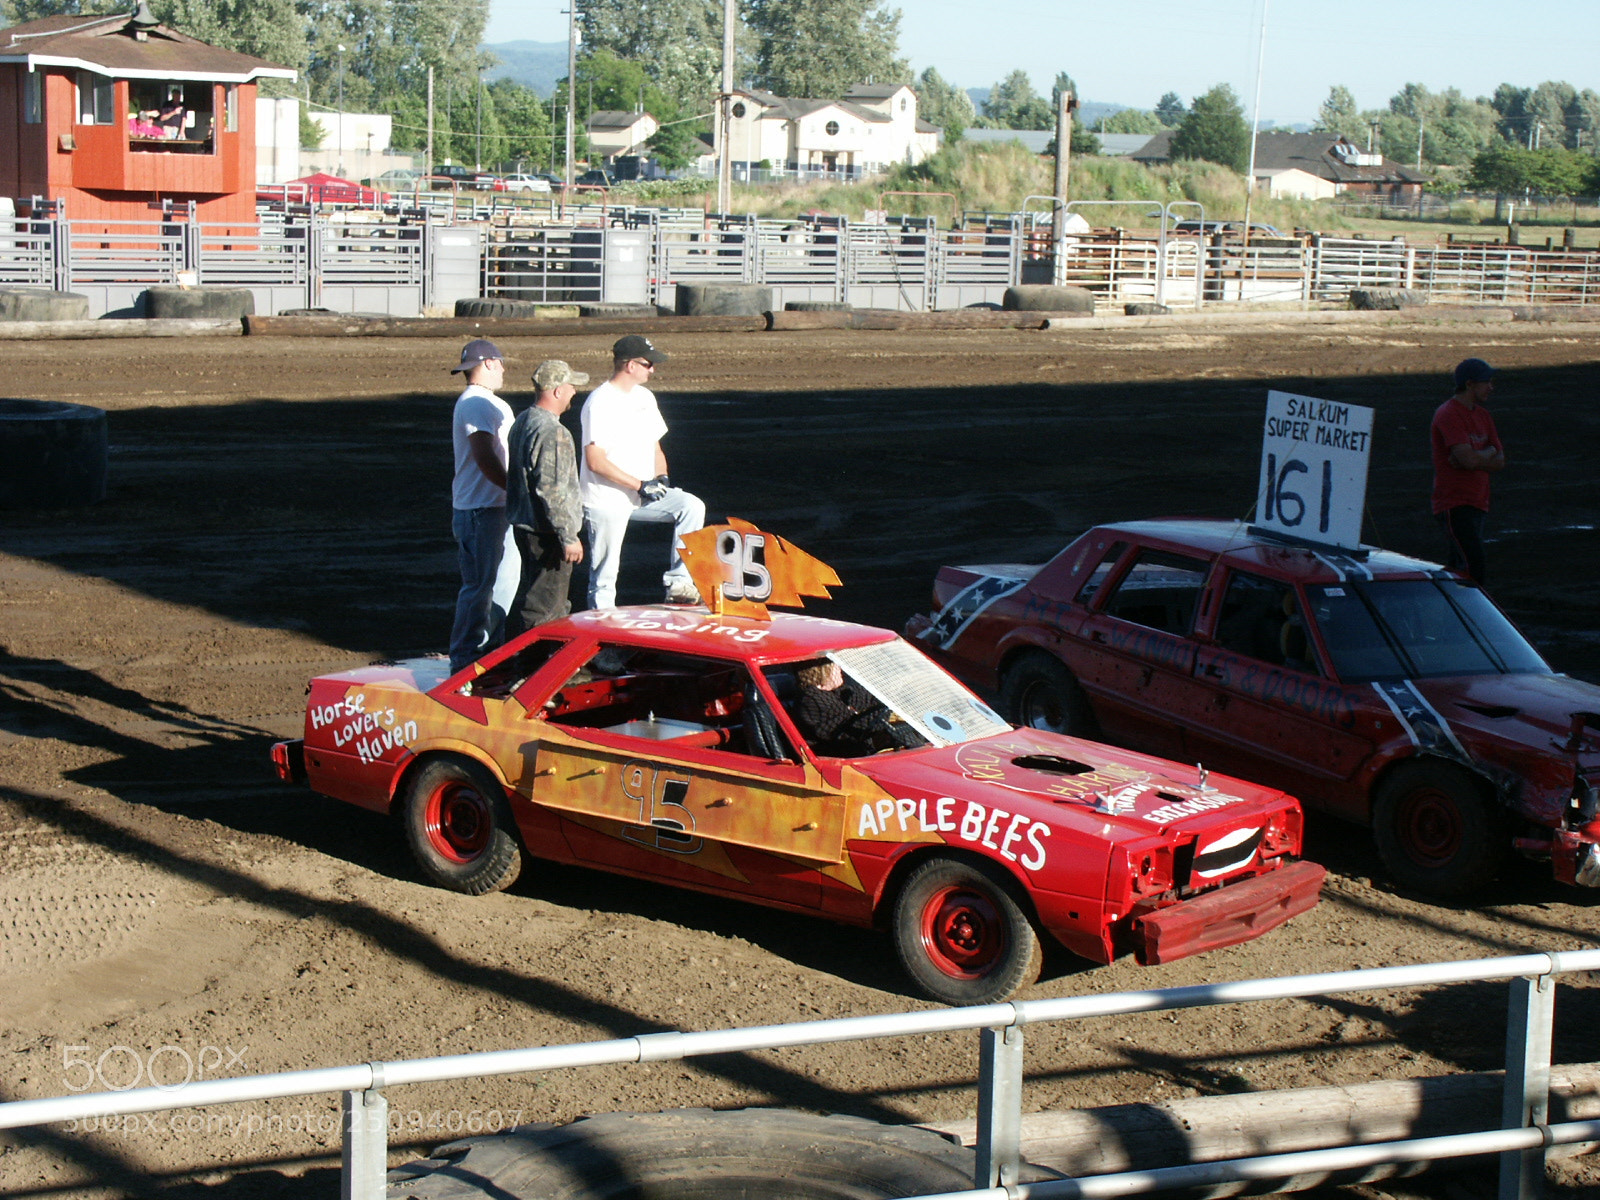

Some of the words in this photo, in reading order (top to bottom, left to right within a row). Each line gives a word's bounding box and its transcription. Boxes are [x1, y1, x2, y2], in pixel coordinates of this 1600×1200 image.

[1287, 399, 1349, 426] SALKUM
[1267, 417, 1310, 442] SUPER
[1315, 426, 1369, 452] MARKET
[1265, 453, 1332, 534] 161
[716, 529, 773, 603] 95
[622, 618, 770, 642] Towing
[311, 692, 366, 730] Horse
[1241, 664, 1260, 695] &
[1261, 669, 1361, 730] DOORS
[333, 706, 395, 748] Lover's
[356, 720, 420, 765] Haven
[621, 758, 704, 854] 95
